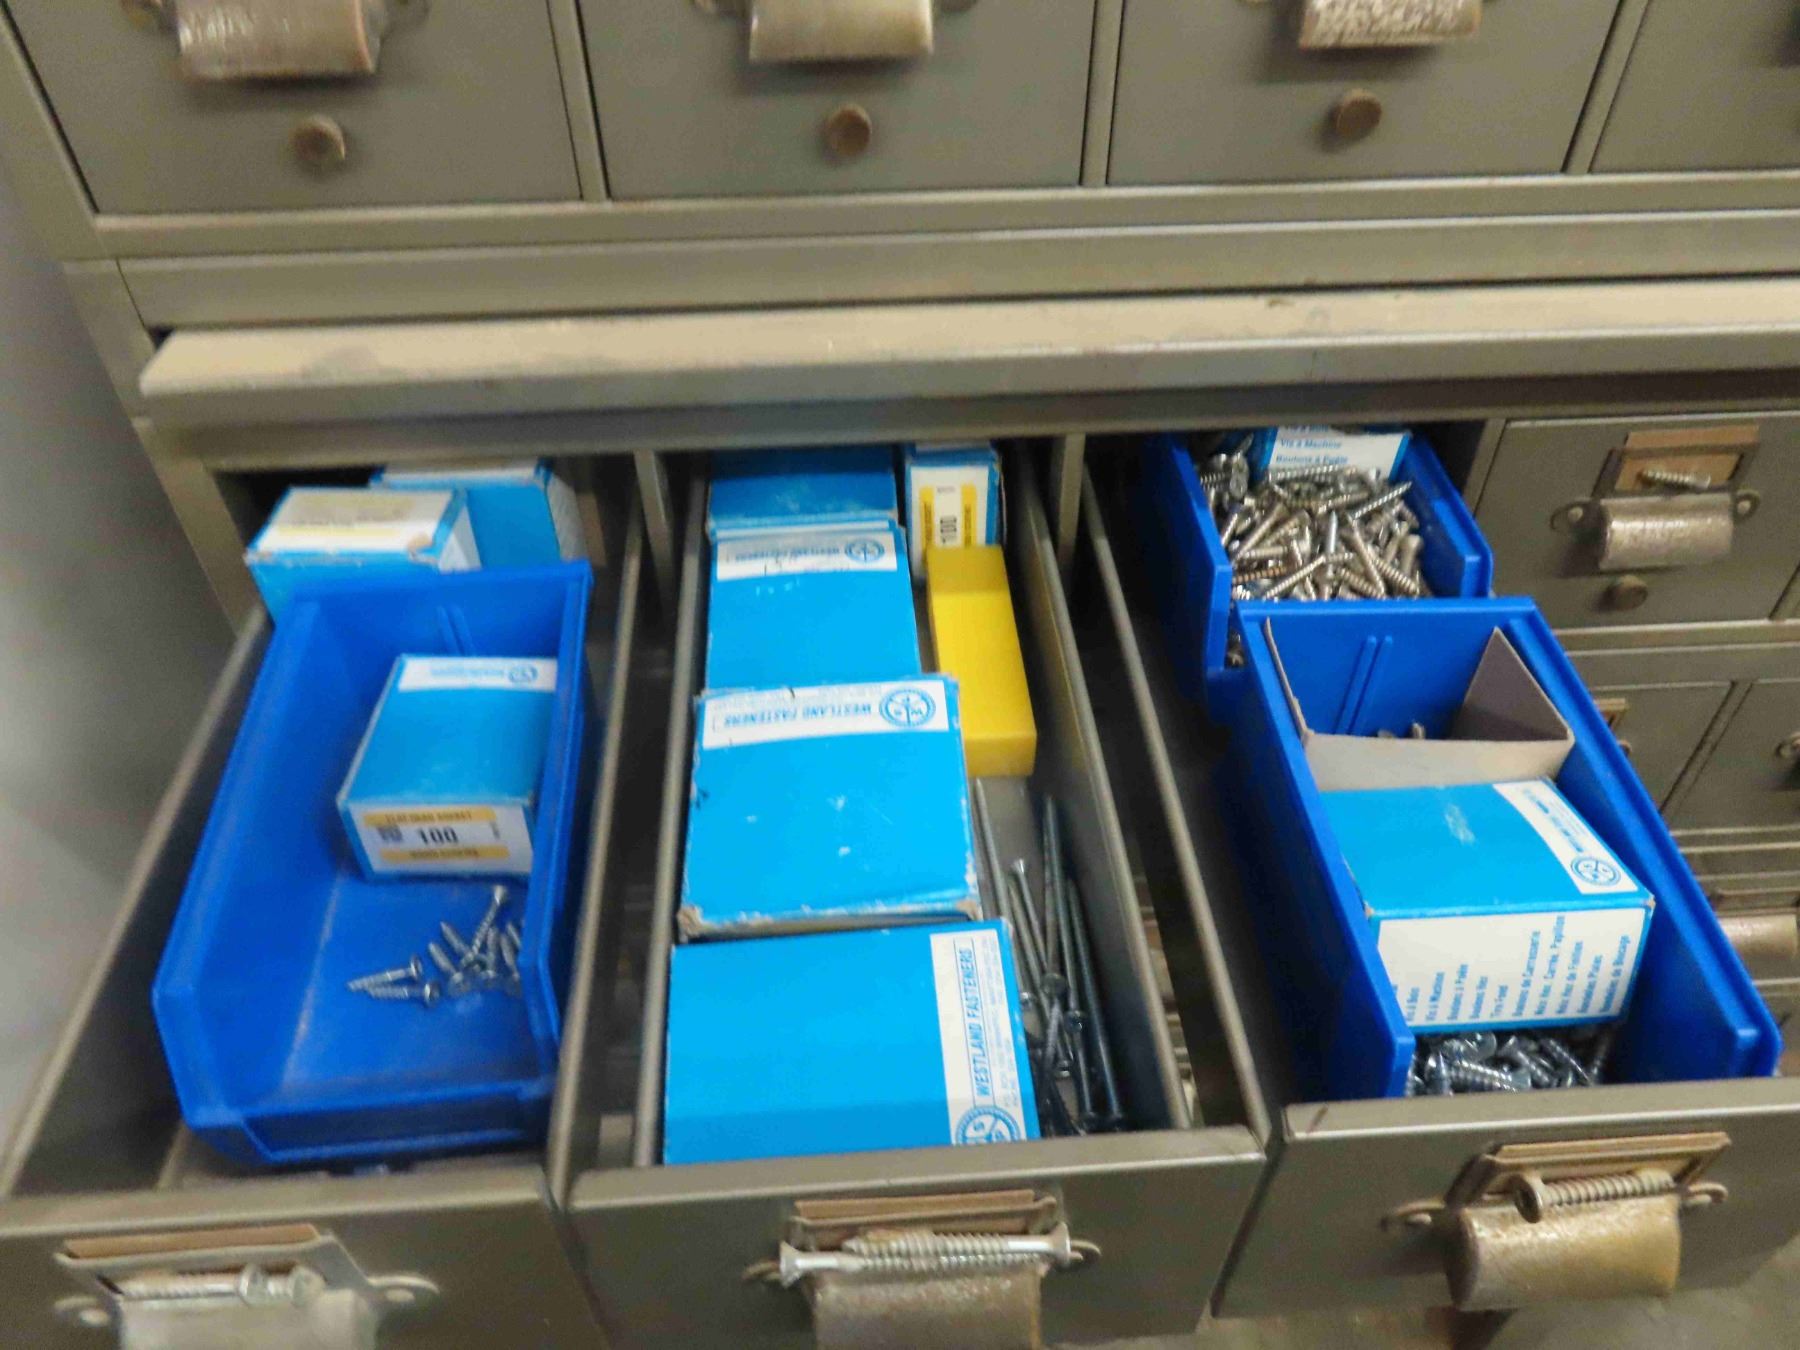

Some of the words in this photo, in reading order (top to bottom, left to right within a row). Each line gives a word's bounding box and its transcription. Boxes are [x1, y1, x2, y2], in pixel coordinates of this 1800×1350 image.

[723, 706, 798, 728] FASTENERS
[802, 703, 872, 720] WESTLAND
[418, 826, 459, 846] 100
[958, 947, 980, 1018] FASTENERS
[968, 1022, 991, 1097] WESTLAND
